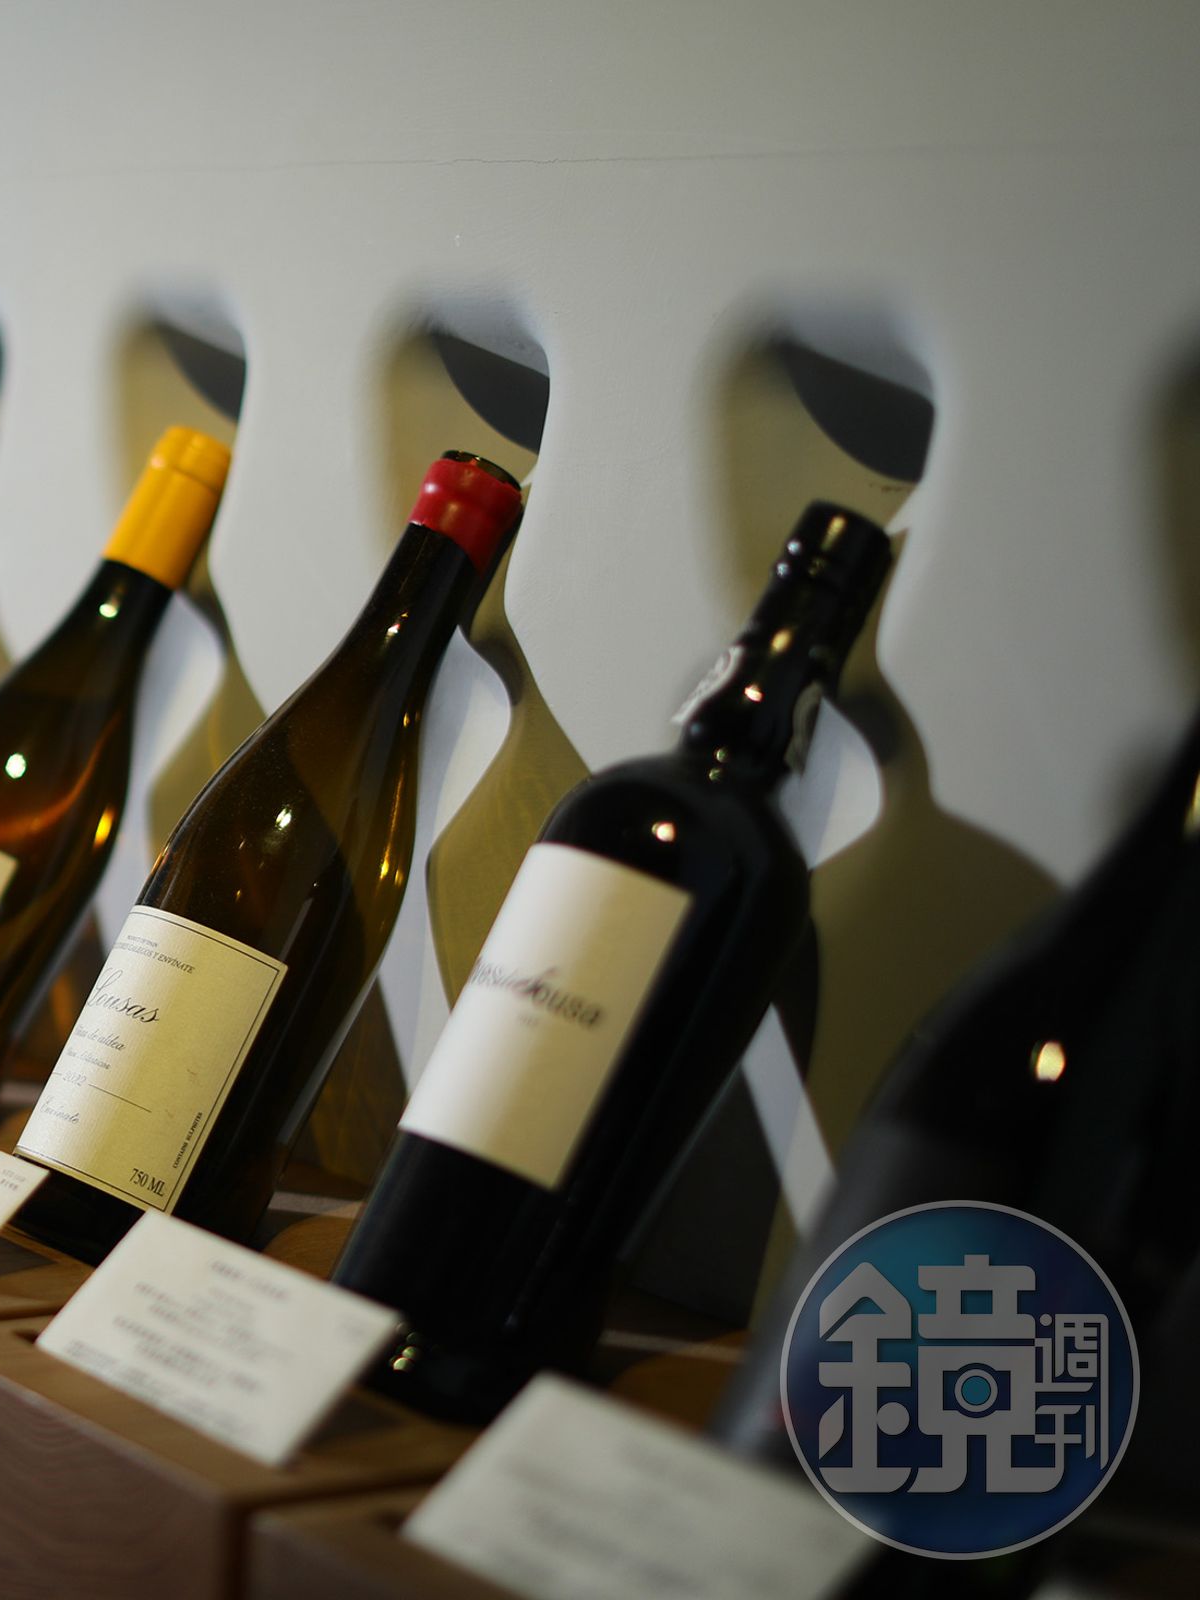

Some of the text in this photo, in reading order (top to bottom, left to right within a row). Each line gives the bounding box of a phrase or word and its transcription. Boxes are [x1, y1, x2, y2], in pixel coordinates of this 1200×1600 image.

[157, 953, 196, 975] ENVÍNATE
[129, 1167, 166, 1198] 750 ML
